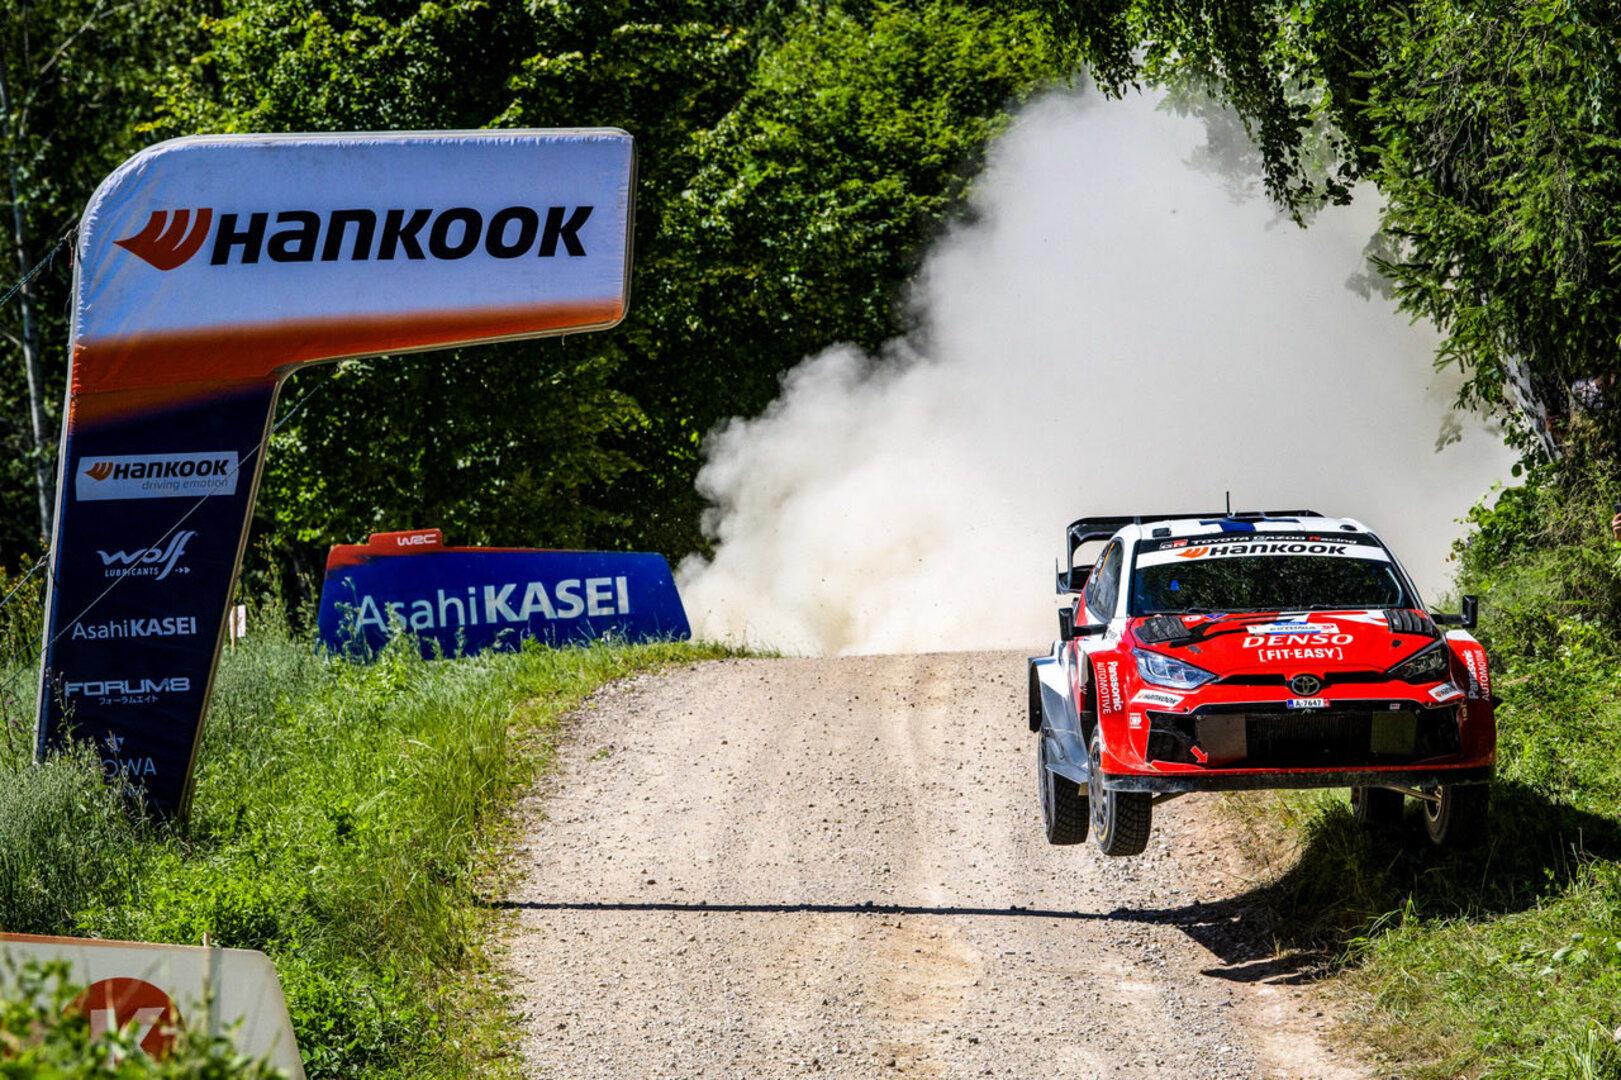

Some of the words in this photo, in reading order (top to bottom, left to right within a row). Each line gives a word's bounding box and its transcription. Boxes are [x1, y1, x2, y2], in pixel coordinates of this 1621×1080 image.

[141, 479, 180, 491] driving
[182, 476, 229, 488] emotion
[1191, 536, 1250, 545] TOYOTA
[104, 567, 160, 577] LUBRICANTS
[1242, 633, 1354, 648] DENSO
[64, 677, 190, 697] FORUM8
[1107, 661, 1124, 711] Panasonic
[101, 756, 157, 777] OWA
